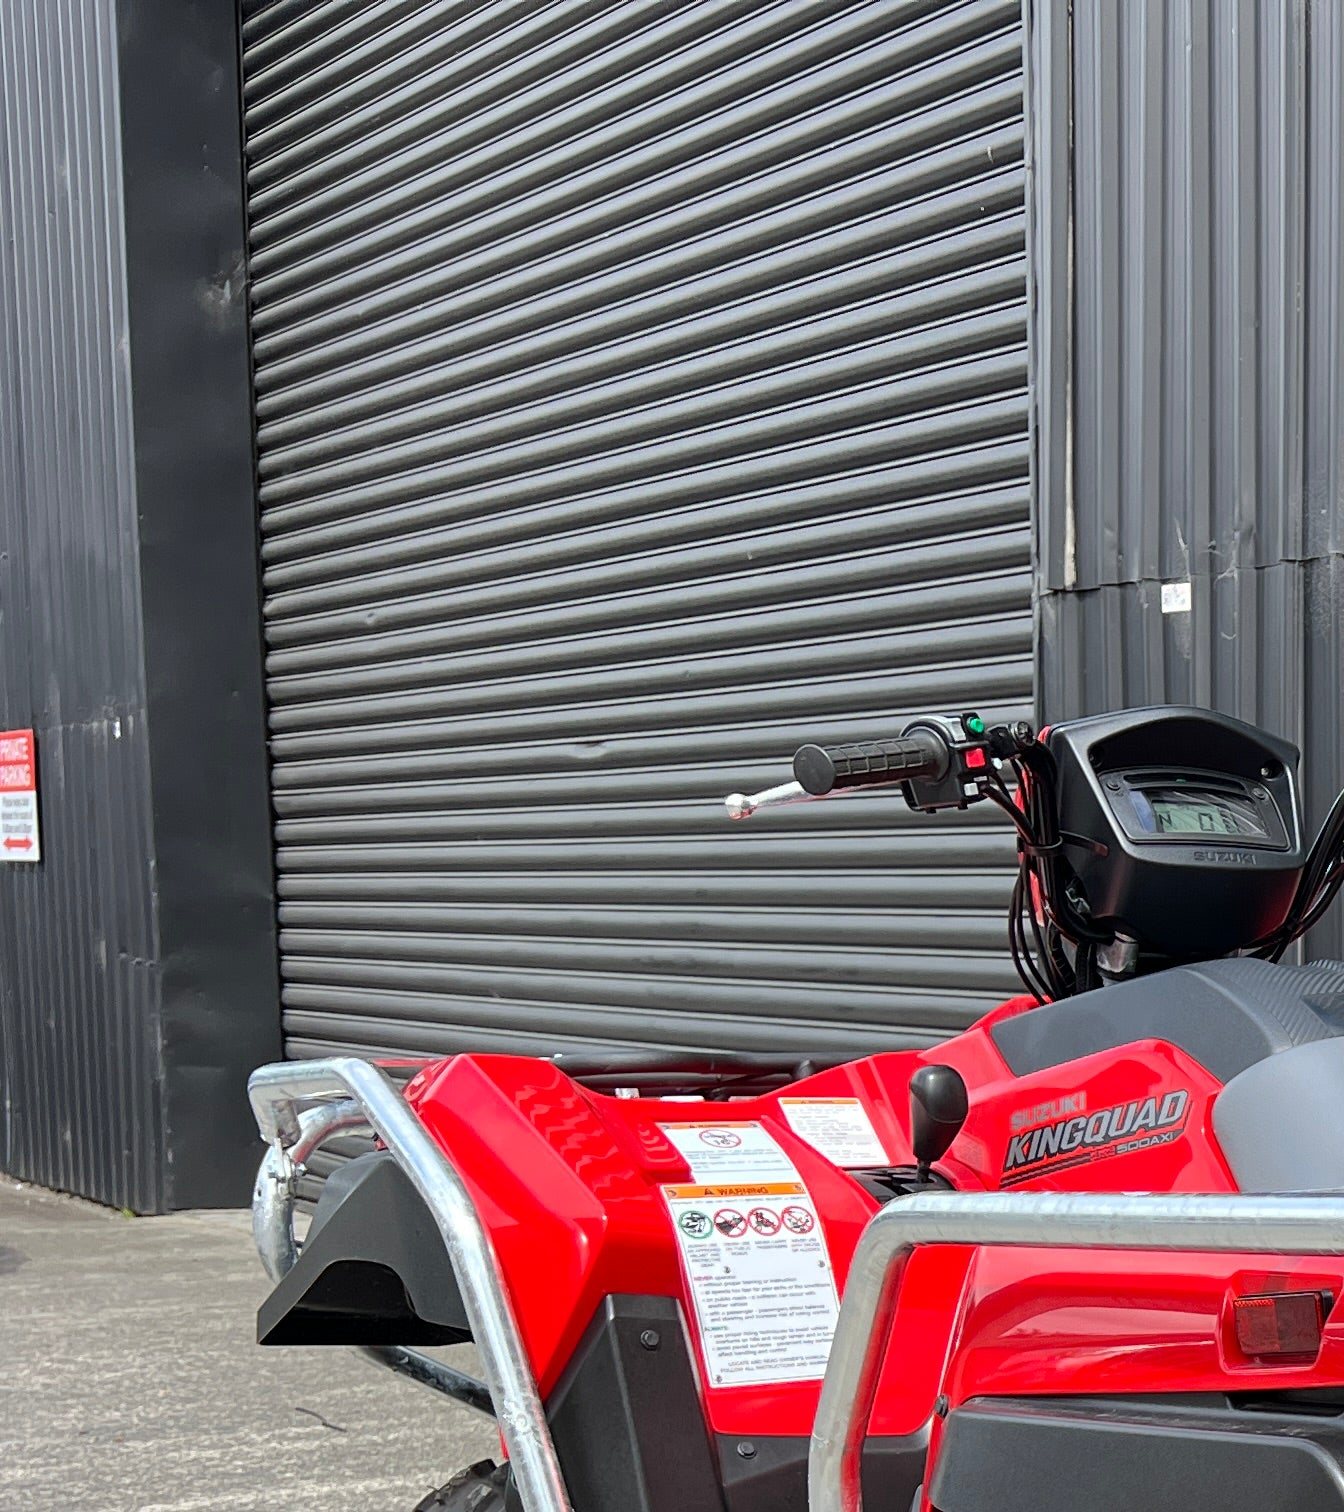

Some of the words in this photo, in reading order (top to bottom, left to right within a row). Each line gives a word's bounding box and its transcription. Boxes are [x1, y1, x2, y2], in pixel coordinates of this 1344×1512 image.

[1193, 850, 1257, 866] SUZUKI
[1004, 1089, 1190, 1172] KINGQUAD
[1009, 1091, 1088, 1131] SUZUKI
